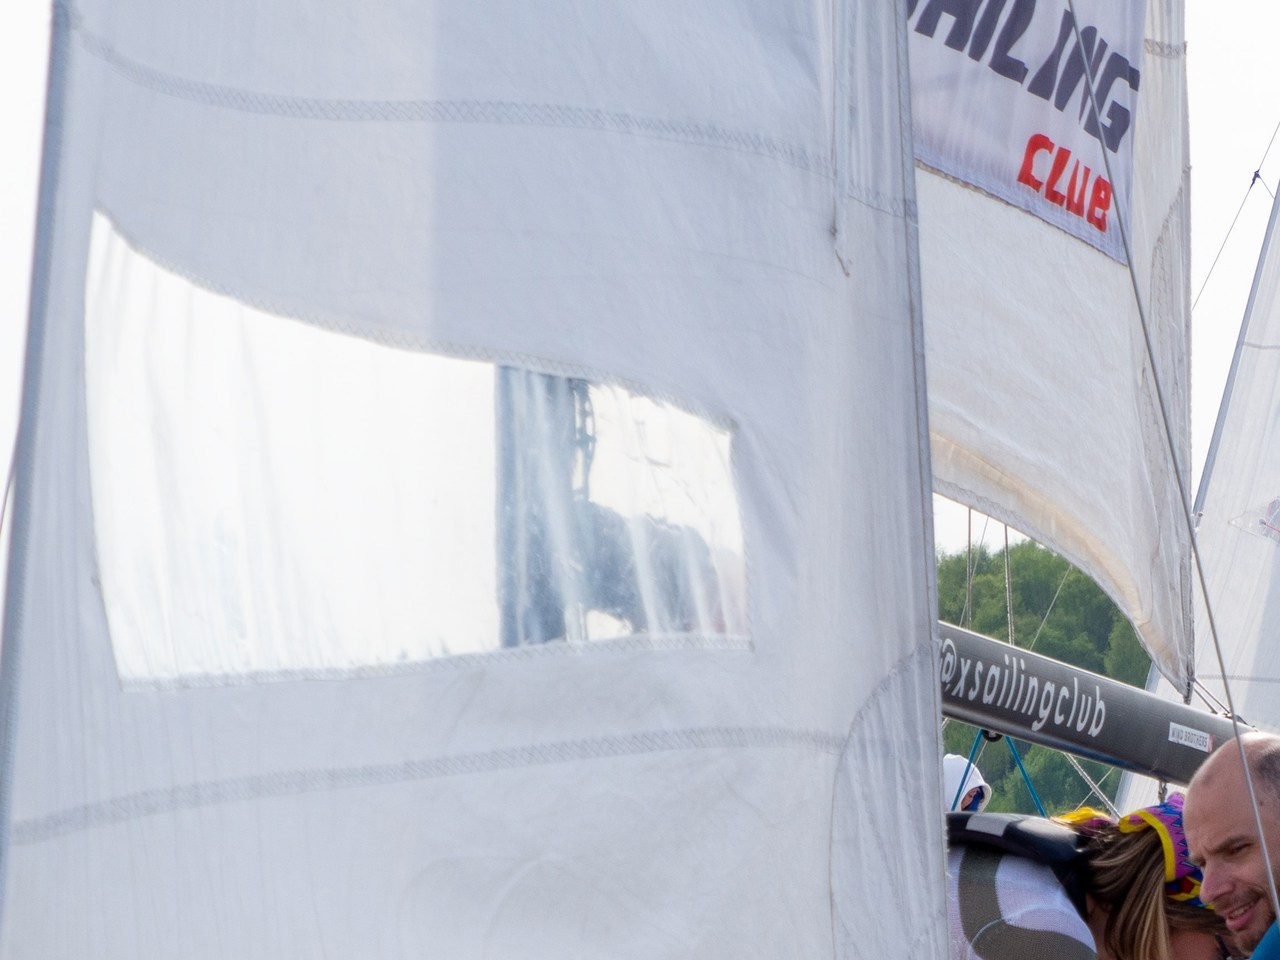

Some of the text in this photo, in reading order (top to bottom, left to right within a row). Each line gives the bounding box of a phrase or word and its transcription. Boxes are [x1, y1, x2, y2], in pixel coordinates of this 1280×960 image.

[907, 0, 1140, 153] AILING
[1016, 133, 1113, 232] CLUB
[941, 638, 1106, 738] @xsailingclub
